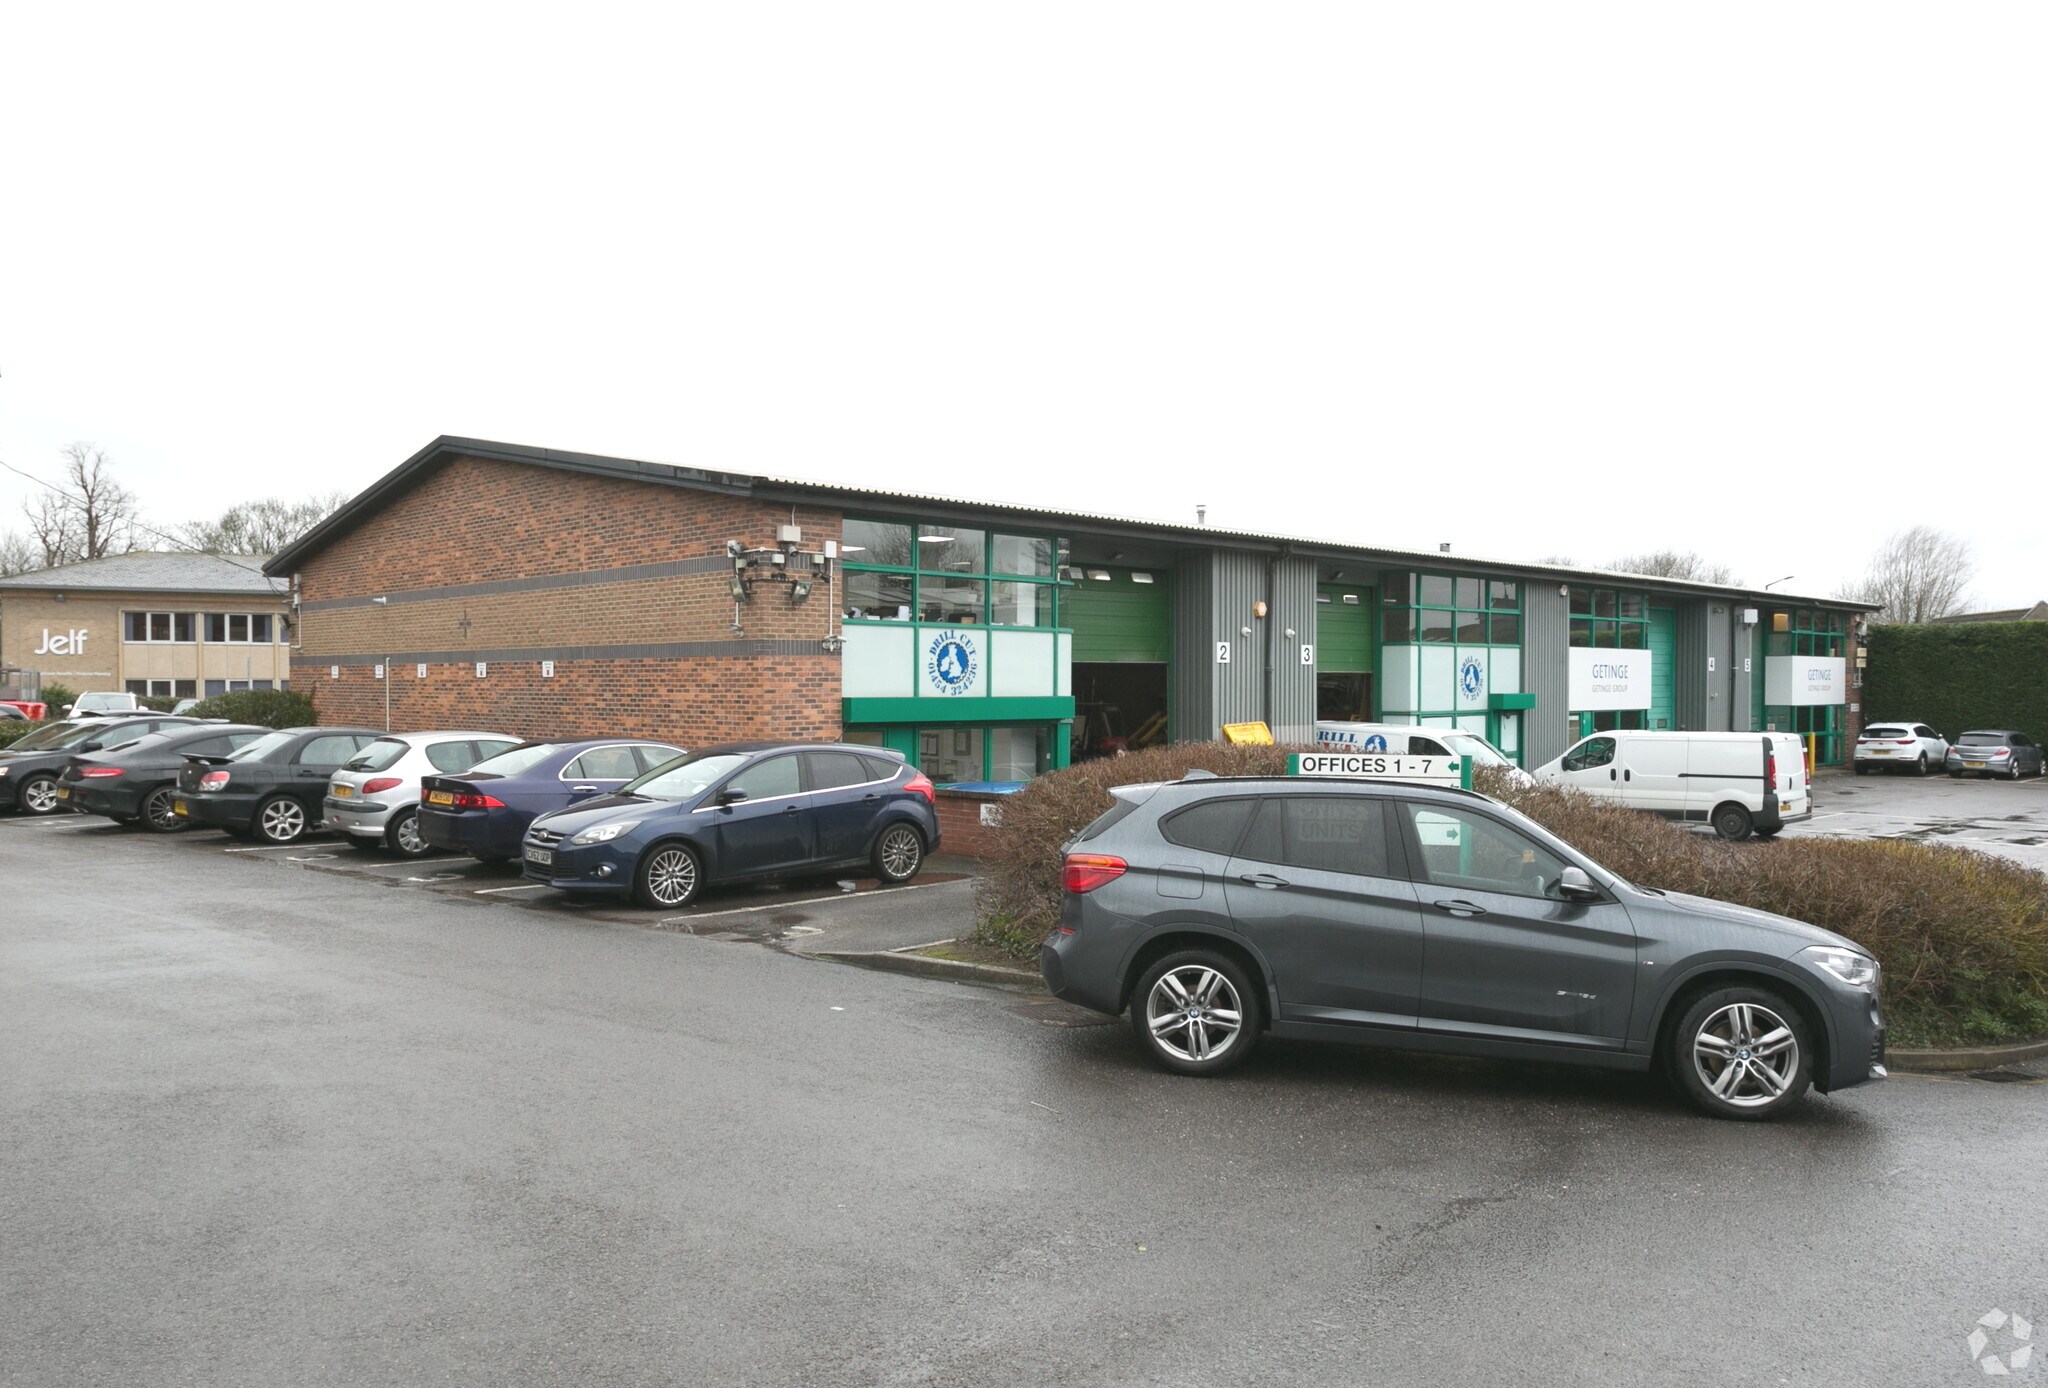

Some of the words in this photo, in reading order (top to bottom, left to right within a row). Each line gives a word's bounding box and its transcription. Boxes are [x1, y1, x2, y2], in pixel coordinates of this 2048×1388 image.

[33, 628, 88, 655] Jelf
[929, 629, 957, 656] DRILL
[959, 633, 977, 656] CUT
[1220, 645, 1227, 660] 2
[1303, 647, 1310, 662] 3
[927, 662, 947, 694] 01454
[950, 663, 978, 696] 324236
[1592, 664, 1628, 679] GETINGE
[1808, 669, 1831, 681] GETINGE
[1591, 684, 1612, 693] GETINGE
[1612, 684, 1628, 693] GROUP
[1317, 730, 1358, 744] RILL
[1302, 757, 1386, 773] OFFICES
[1393, 759, 1401, 773] 1
[1421, 759, 1432, 774] 7
[1301, 822, 1360, 839] UNITS
